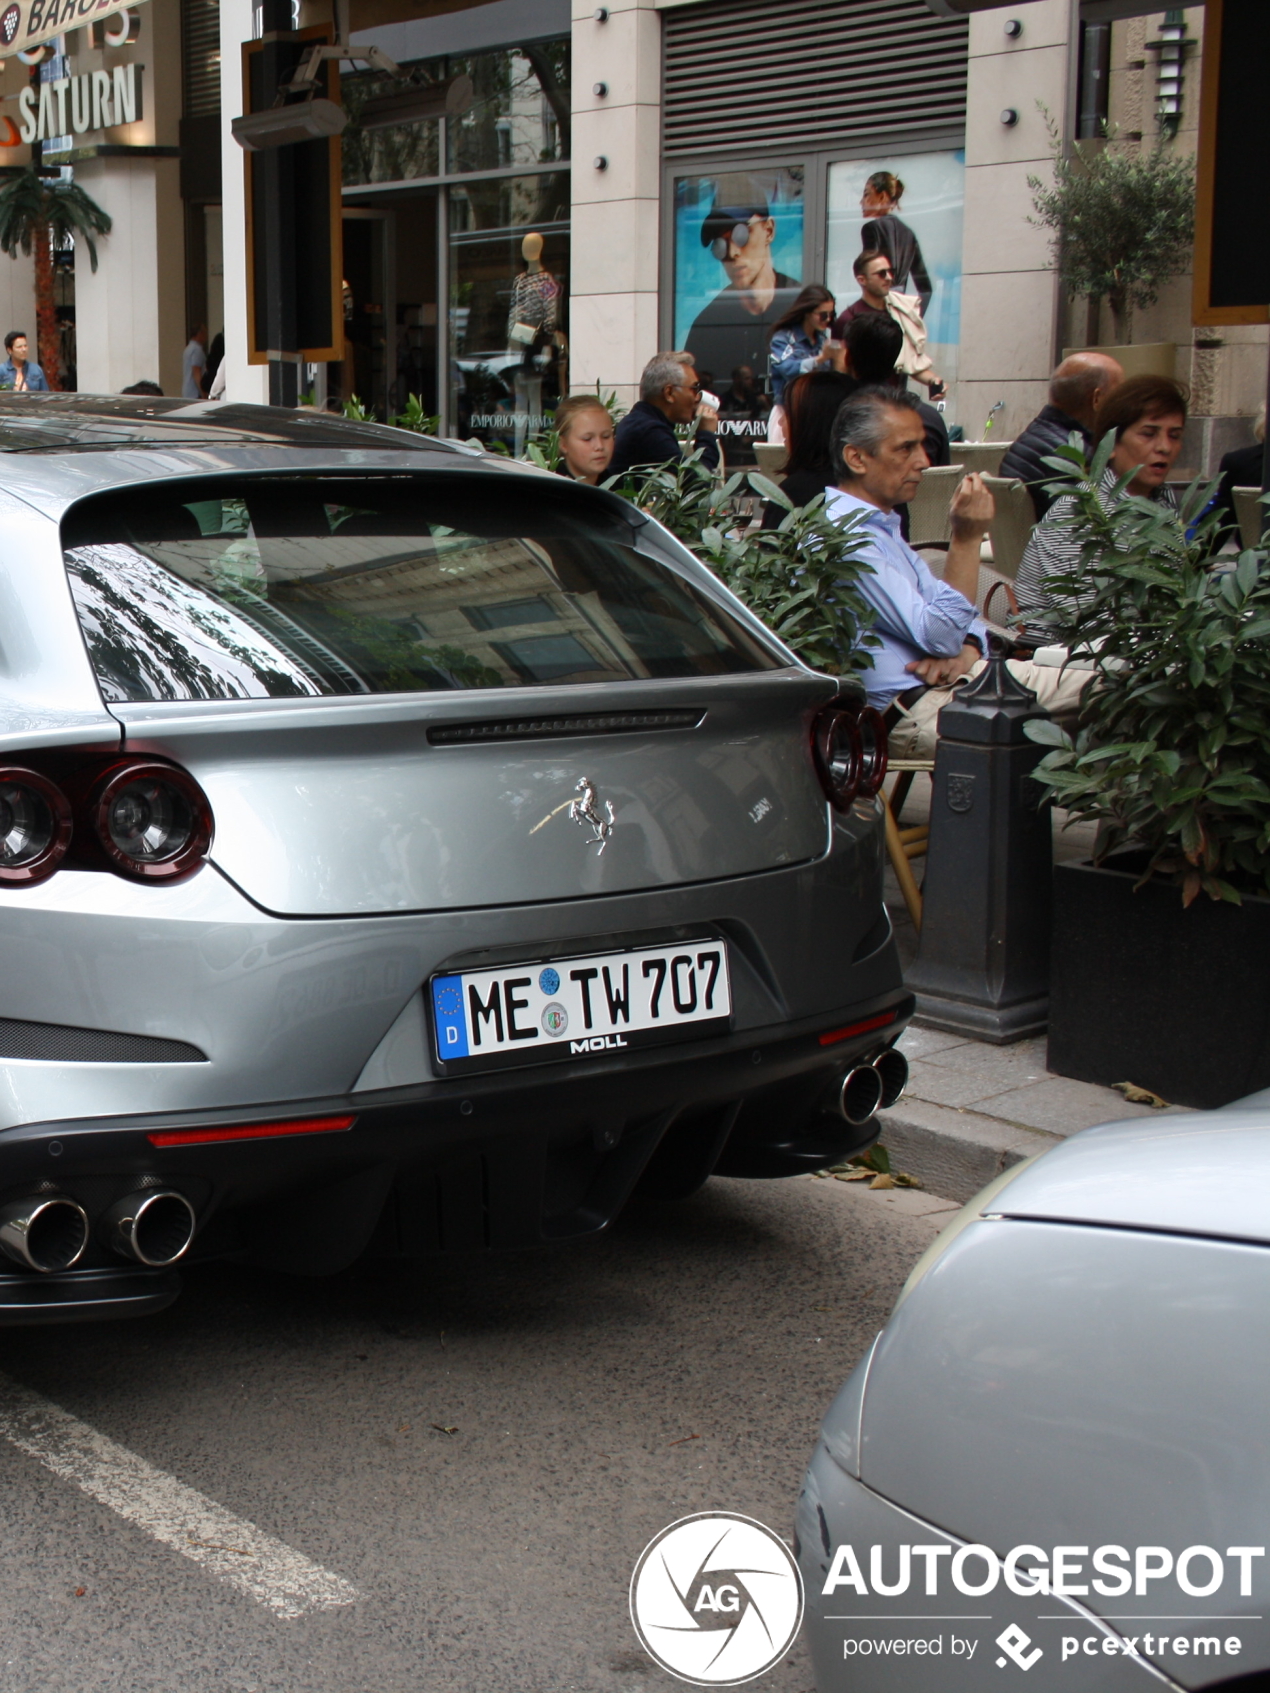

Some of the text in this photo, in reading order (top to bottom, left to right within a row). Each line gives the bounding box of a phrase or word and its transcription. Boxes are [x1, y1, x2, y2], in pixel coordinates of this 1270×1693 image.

[19, 63, 136, 144] SATURN
[467, 977, 538, 1046] ME
[570, 963, 630, 1029] TW
[641, 951, 720, 1018] 707
[446, 1026, 458, 1044] D
[570, 1034, 628, 1054] MOLL
